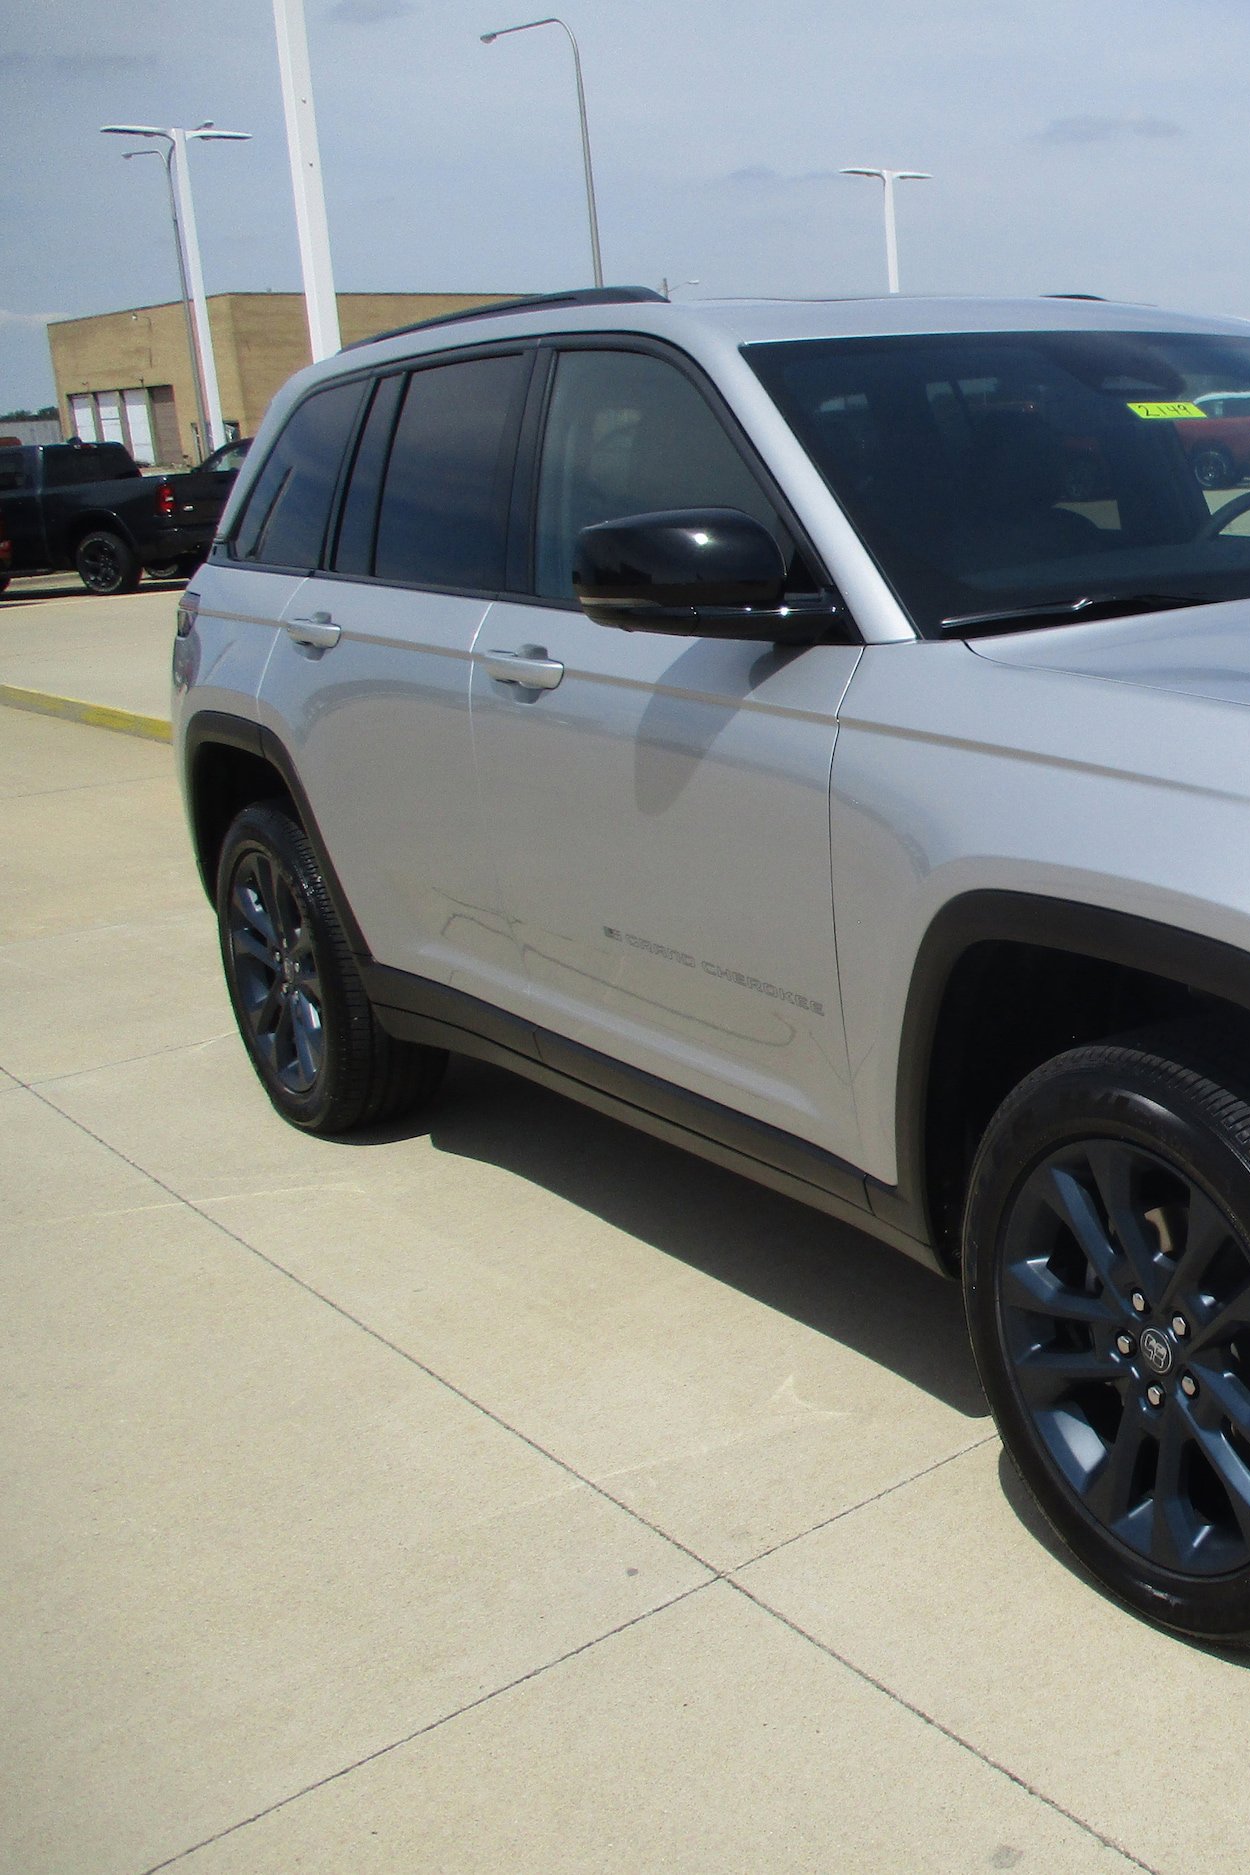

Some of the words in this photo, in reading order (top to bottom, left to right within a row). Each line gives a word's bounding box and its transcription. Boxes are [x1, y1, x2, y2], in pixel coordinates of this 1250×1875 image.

[1137, 404, 1192, 417] 2149
[625, 933, 697, 968] GRAND
[701, 960, 825, 1017] CHEROKEE
